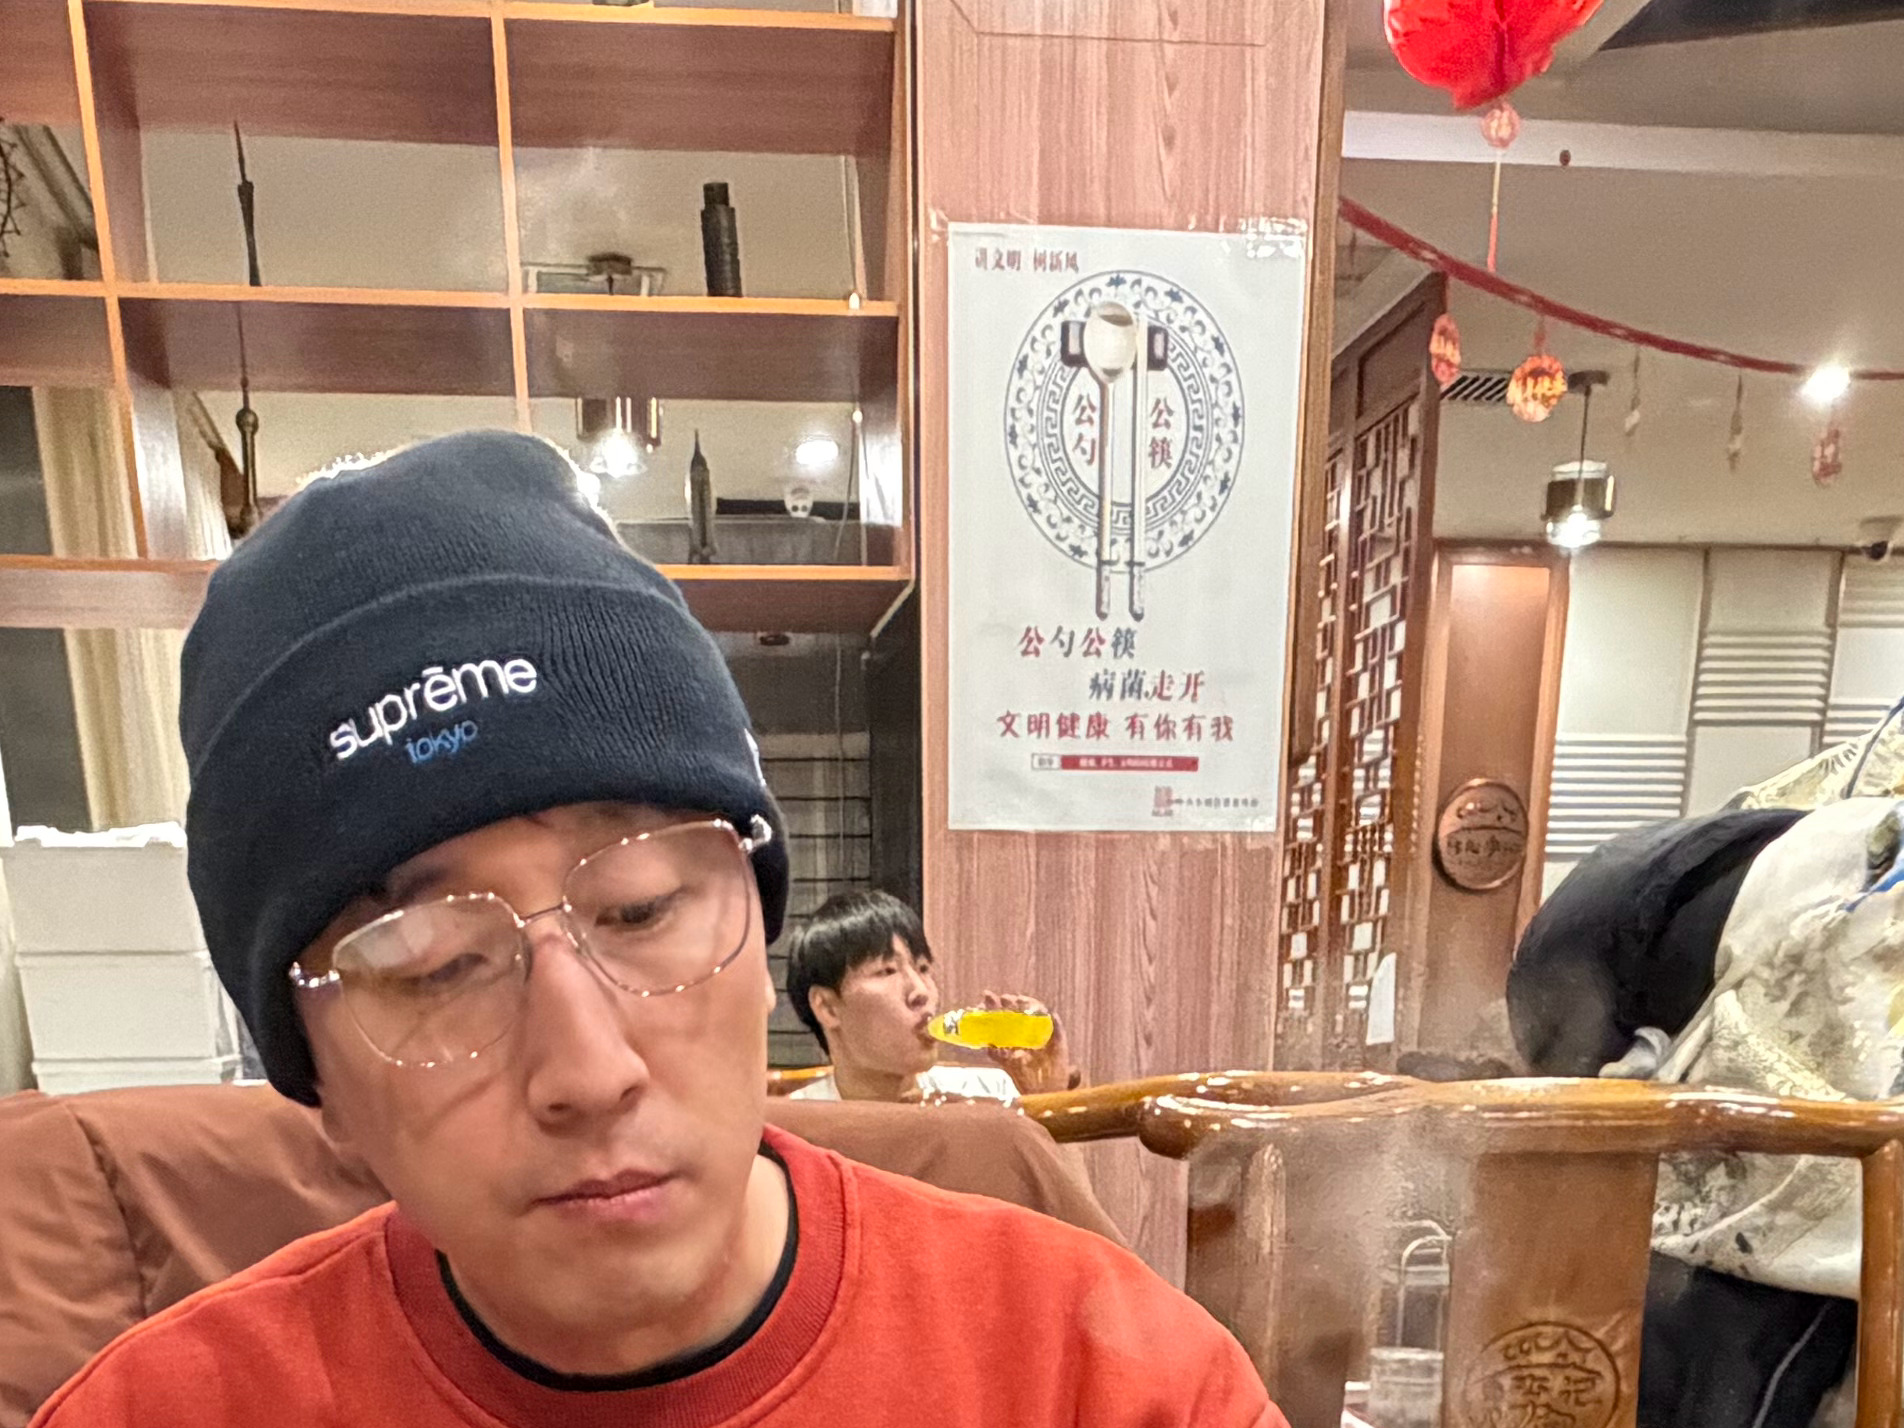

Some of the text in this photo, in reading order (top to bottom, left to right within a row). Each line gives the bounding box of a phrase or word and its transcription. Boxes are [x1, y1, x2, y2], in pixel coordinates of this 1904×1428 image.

[1072, 393, 1096, 466] 公勺
[1147, 396, 1175, 469] 公筷
[1017, 625, 1138, 660] 公勺公筷
[1088, 668, 1206, 704] 病菌走开
[996, 709, 1235, 742] 文明健康 有你有我
